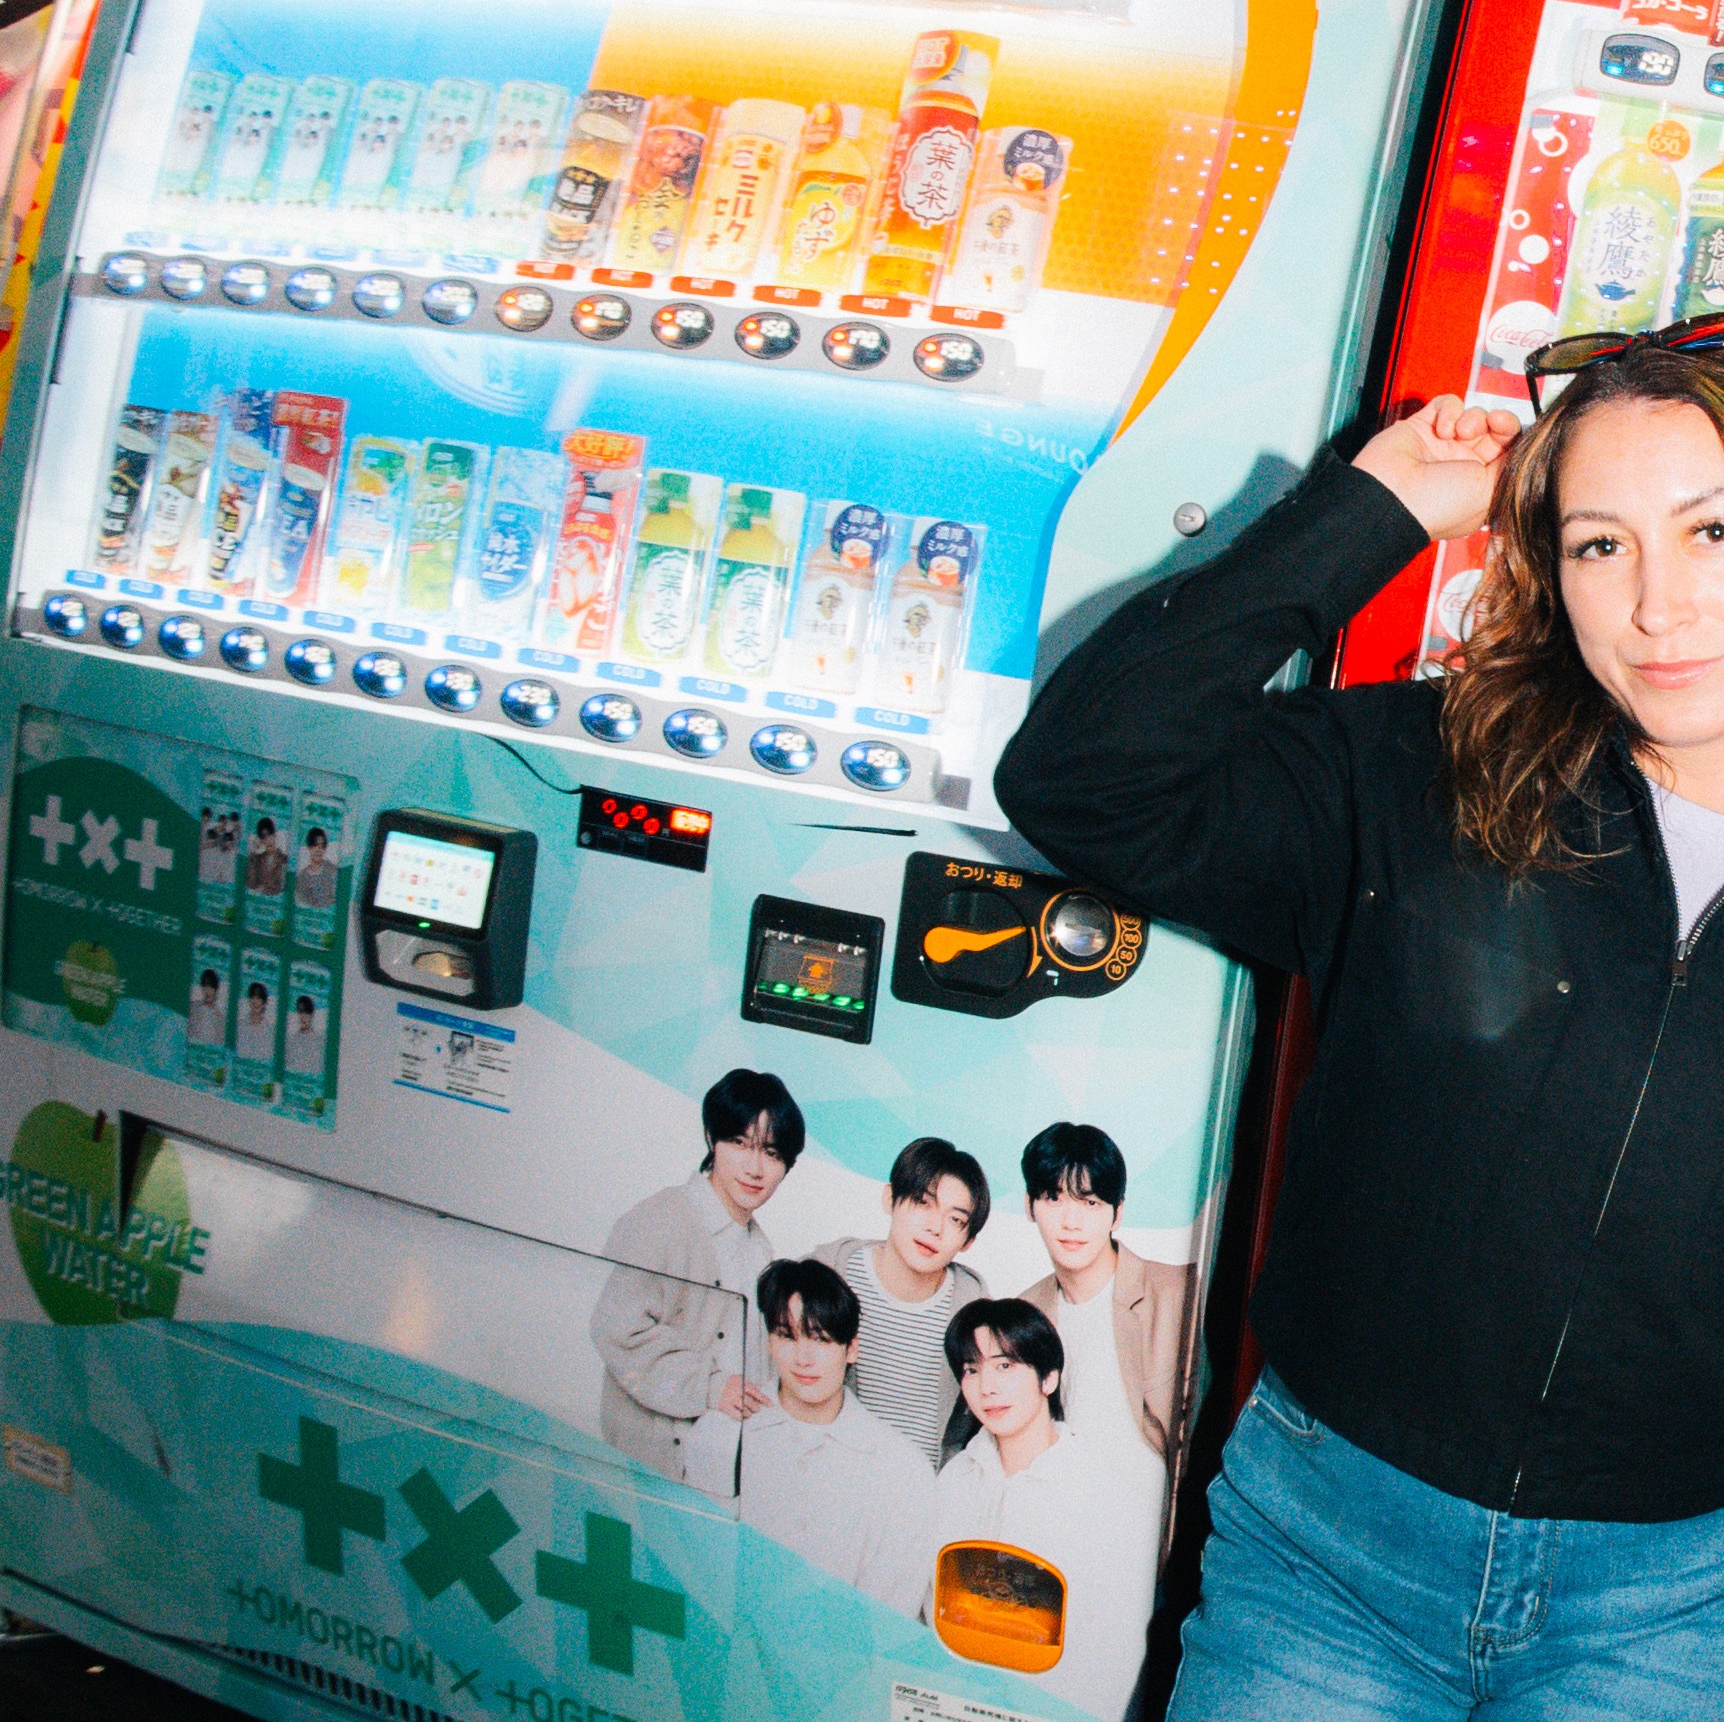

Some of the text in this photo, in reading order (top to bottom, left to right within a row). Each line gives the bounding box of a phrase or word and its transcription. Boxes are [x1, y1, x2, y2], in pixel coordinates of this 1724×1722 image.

[916, 140, 960, 212] 葉の茶
[1600, 205, 1643, 278] 綾鷹
[944, 859, 1024, 890] おつり・返却
[1110, 963, 1123, 976] 10
[39, 1227, 150, 1308] WATER
[95, 1207, 211, 1276] APPLE
